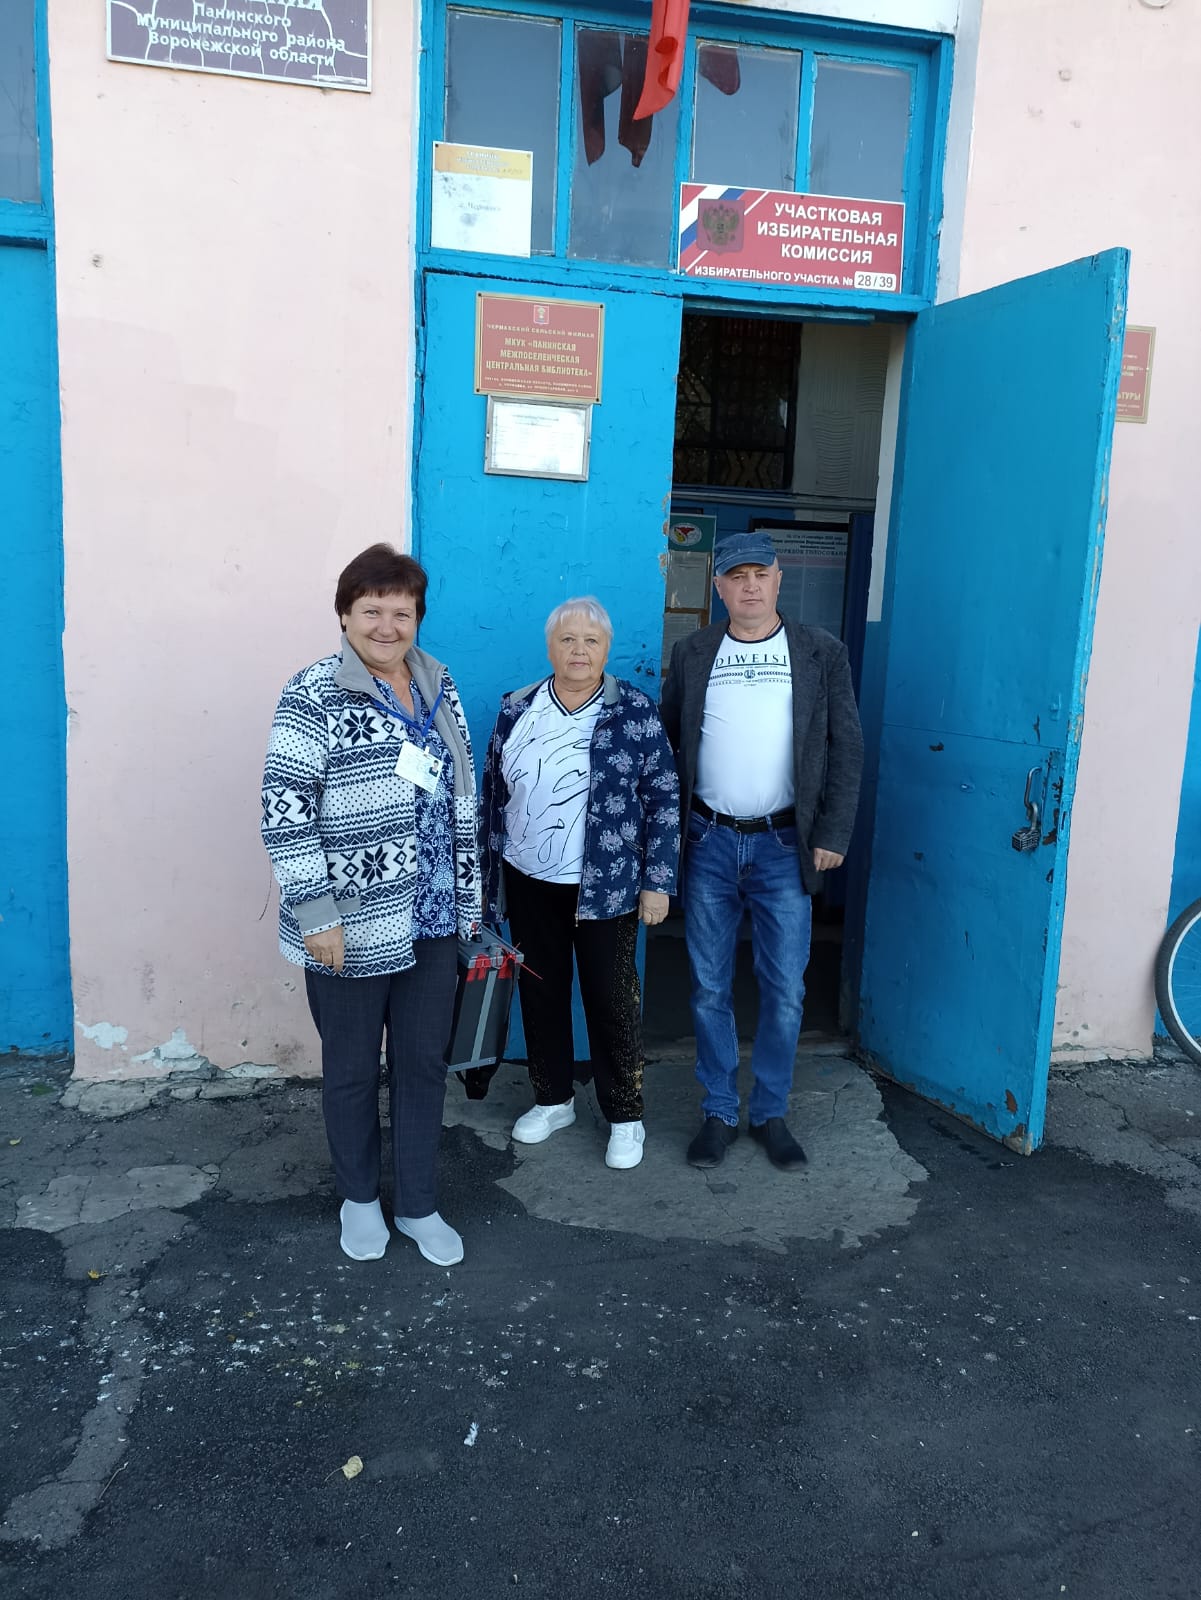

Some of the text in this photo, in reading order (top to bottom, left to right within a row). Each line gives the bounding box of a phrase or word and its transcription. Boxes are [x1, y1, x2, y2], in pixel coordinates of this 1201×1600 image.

[195, 4, 292, 27] Панинского
[137, 12, 345, 52] Муниципального района
[150, 31, 333, 66] Воронежской области
[774, 202, 882, 226] УЧАСТКОВАЯ
[757, 221, 898, 246] ИЗБИРАТЕЛЬНАЯ
[781, 243, 873, 265] КОМИССИЯ
[694, 265, 790, 282] ИЗБИРАТЕЛЬНОГО
[794, 273, 840, 285] УЧАСТКА
[504, 337, 526, 347] МКУК
[486, 360, 540, 373] ЦЕНТРАЛЬНАЯ
[500, 349, 580, 364] МЕЖПОСЕЛЕНЧЕСКАЯ
